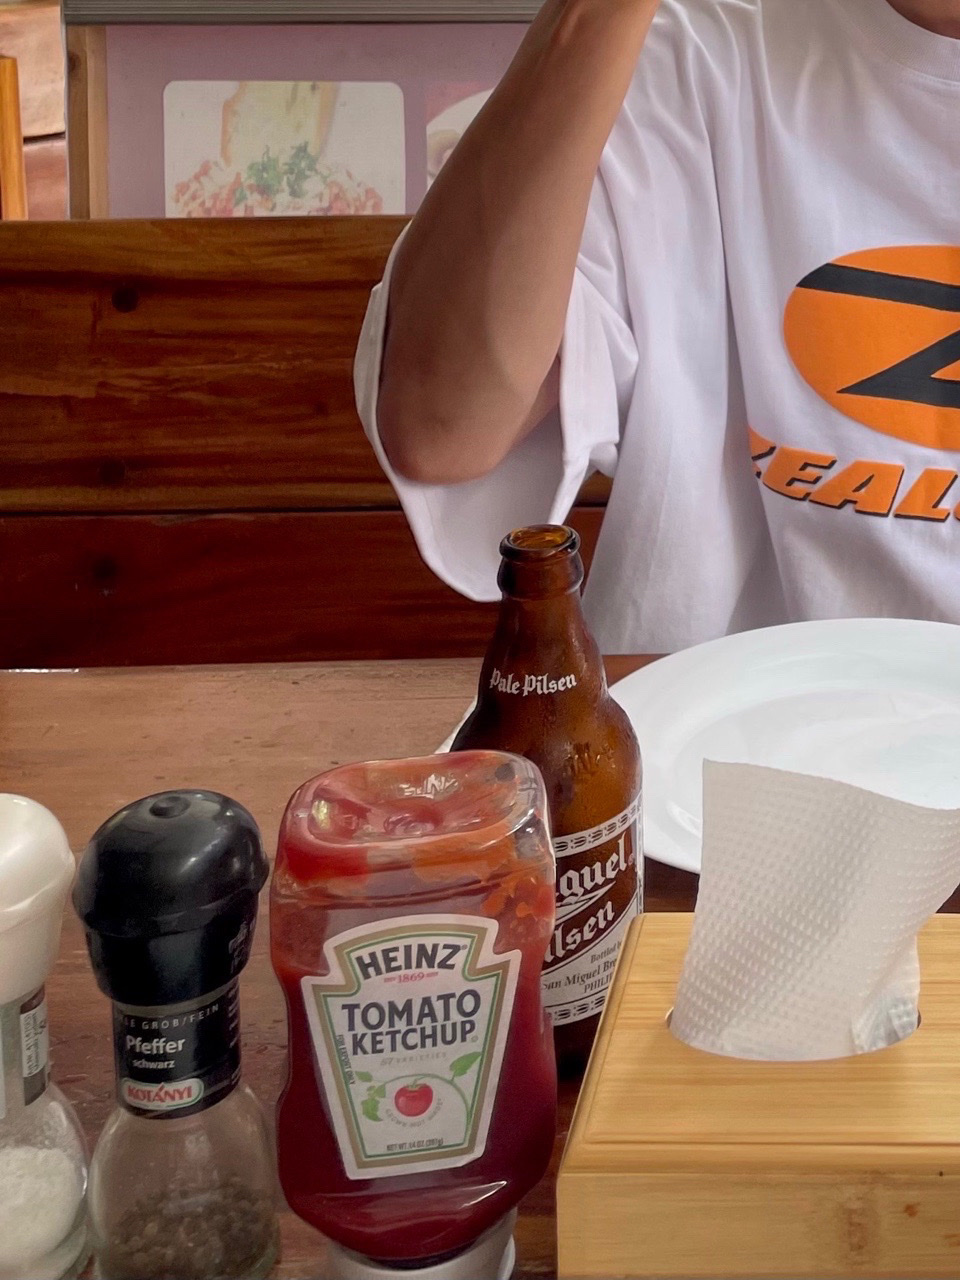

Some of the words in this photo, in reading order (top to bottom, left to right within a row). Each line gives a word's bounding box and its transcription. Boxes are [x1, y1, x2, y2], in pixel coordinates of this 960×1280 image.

[489, 667, 521, 695] Pale
[522, 672, 577, 697] Pilsen
[555, 831, 628, 904] guel
[544, 900, 615, 963] ilsen
[355, 943, 461, 980] HEINZ
[590, 942, 617, 964] Bottled
[397, 971, 425, 984] 1869
[564, 965, 601, 987] Miguel
[603, 958, 617, 972] Bre
[142, 1004, 219, 1030] GROB/FEIN
[341, 989, 481, 1032] TOMATO
[126, 1034, 186, 1055] Pfeffer
[352, 1020, 476, 1056] KETCHUP
[132, 1058, 175, 1069] schwarz
[127, 1082, 192, 1103] KOTÁNYI
